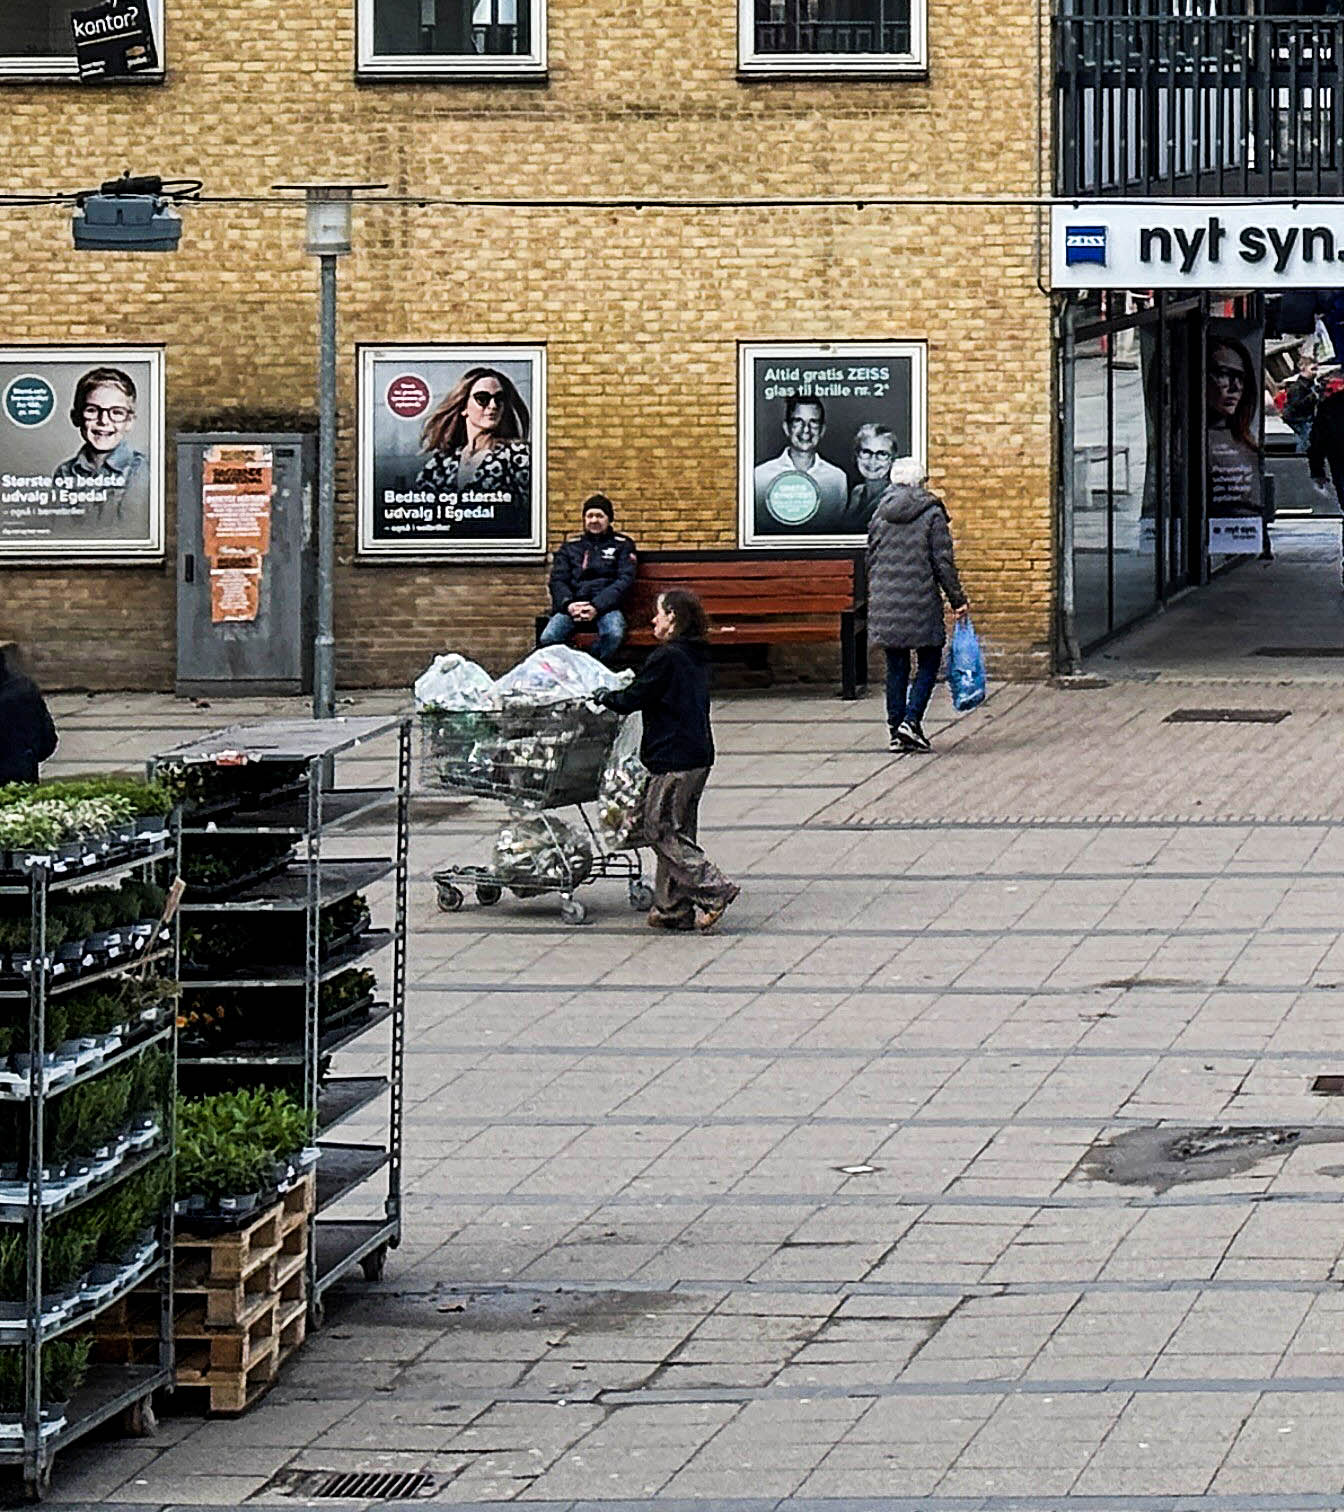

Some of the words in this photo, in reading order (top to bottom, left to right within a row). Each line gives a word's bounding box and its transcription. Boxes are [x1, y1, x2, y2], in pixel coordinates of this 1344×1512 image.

[72, 6, 139, 38] kontor?
[1139, 216, 1227, 274] nyt
[763, 367, 800, 382] Altid
[803, 368, 845, 383] gratis
[847, 367, 890, 381] ZEISS
[764, 384, 796, 400] glas
[797, 384, 812, 397] til
[814, 384, 851, 397] brille
[1, 474, 53, 488] Største
[54, 476, 74, 490] og
[76, 474, 126, 488] bedste
[1, 490, 49, 505] udvalg
[59, 490, 108, 505] Egedal
[383, 489, 436, 503] Bedste
[438, 491, 459, 505] og
[461, 489, 512, 503] største
[383, 505, 434, 521] udvalg
[444, 505, 495, 521] Egedal
